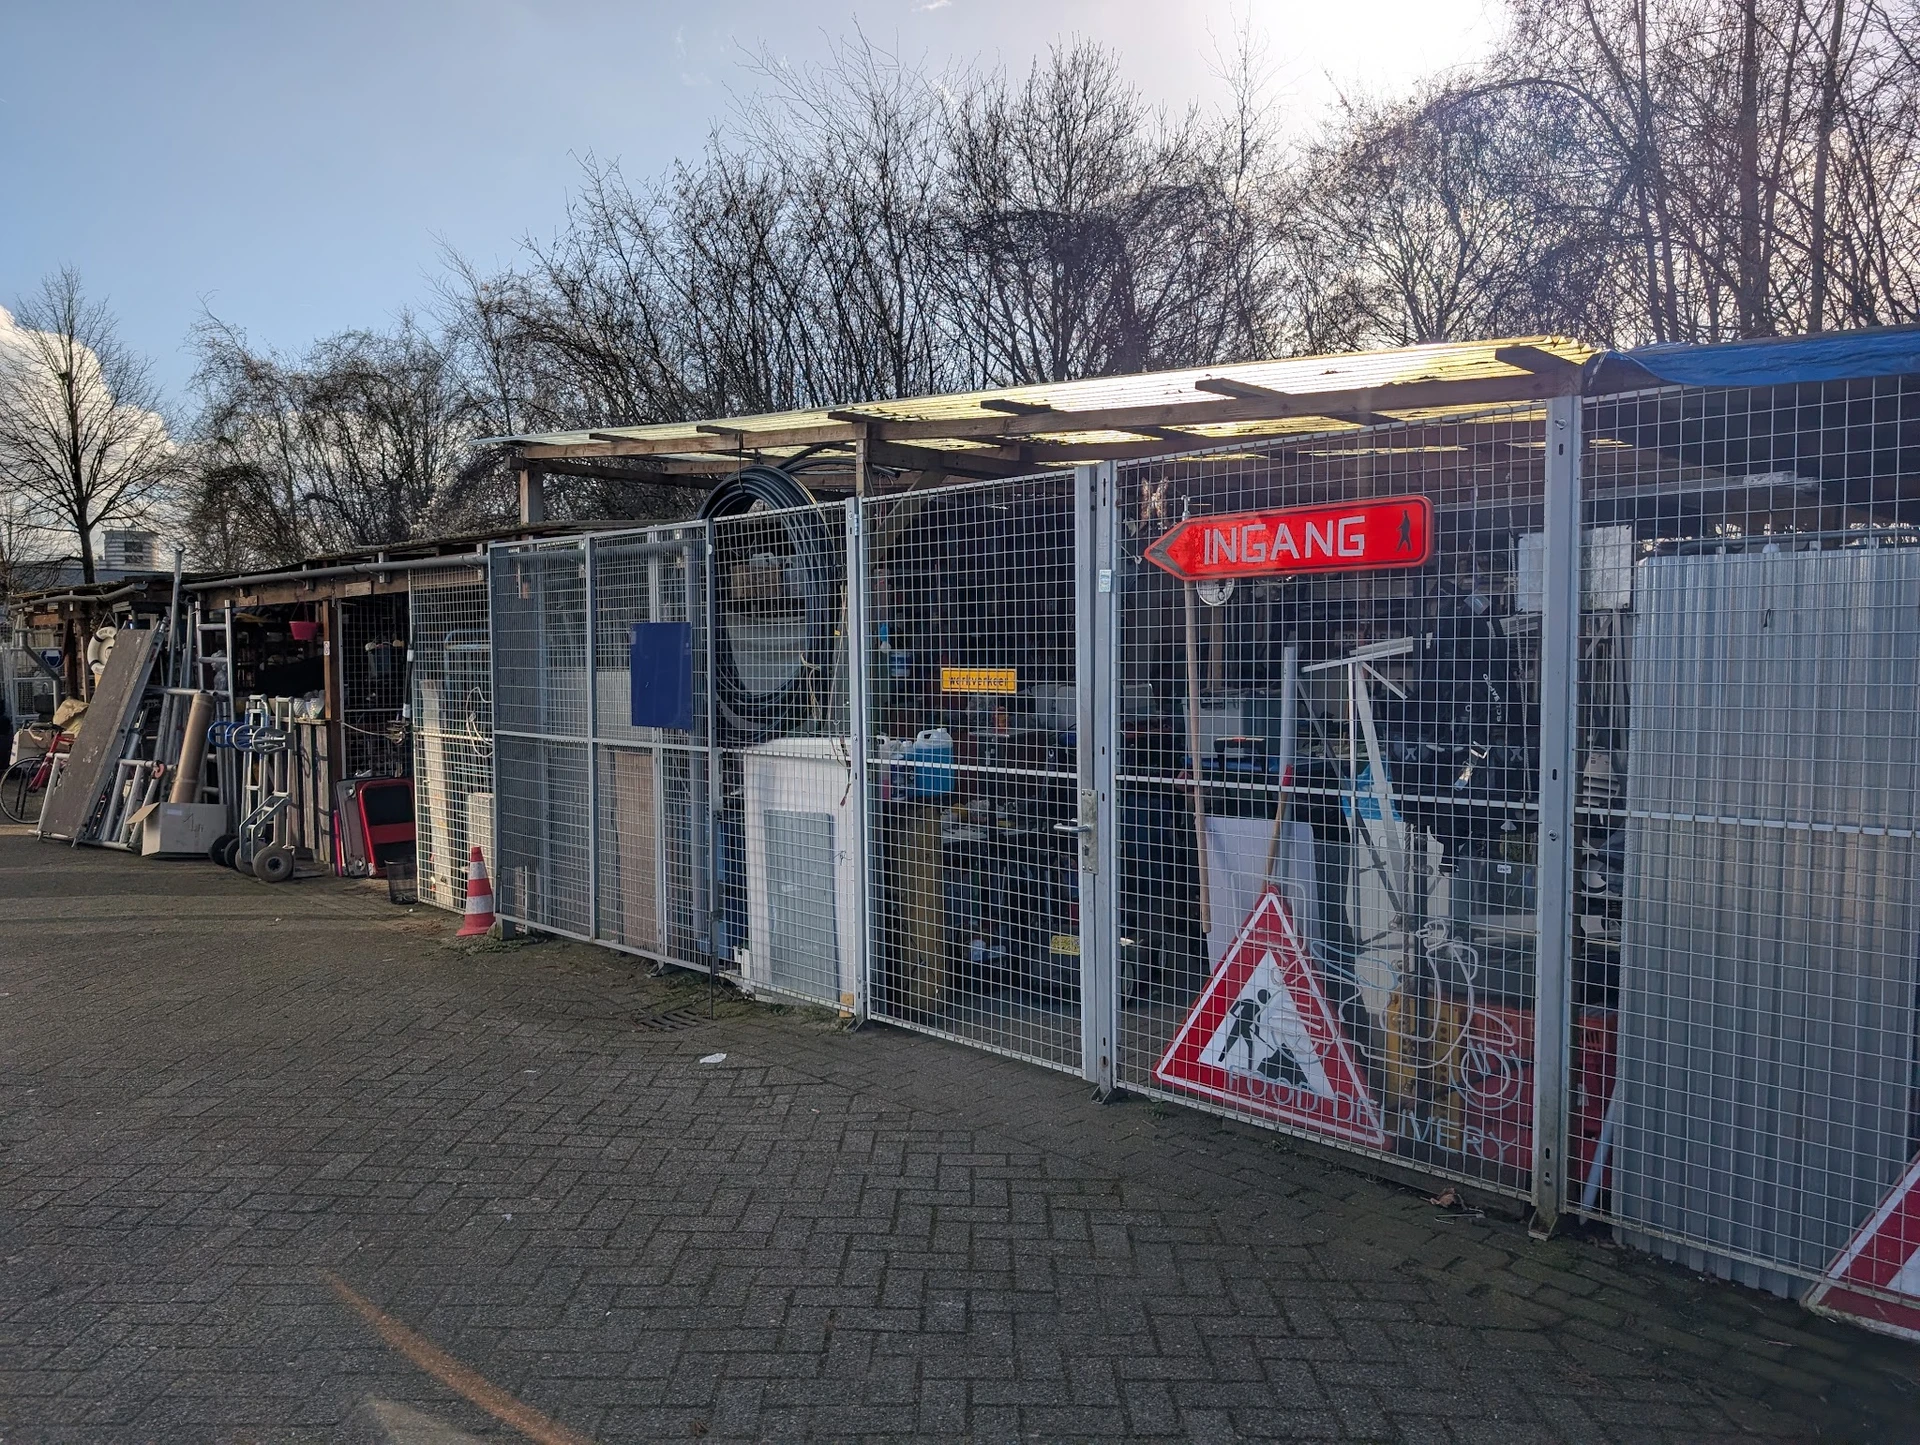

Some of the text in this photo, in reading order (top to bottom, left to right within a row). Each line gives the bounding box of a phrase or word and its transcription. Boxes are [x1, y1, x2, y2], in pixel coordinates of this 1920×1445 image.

[1203, 515, 1366, 565] INGANG
[948, 674, 1009, 687] werkverkeer
[1228, 1064, 1518, 1167] FOOD DELIVERY
